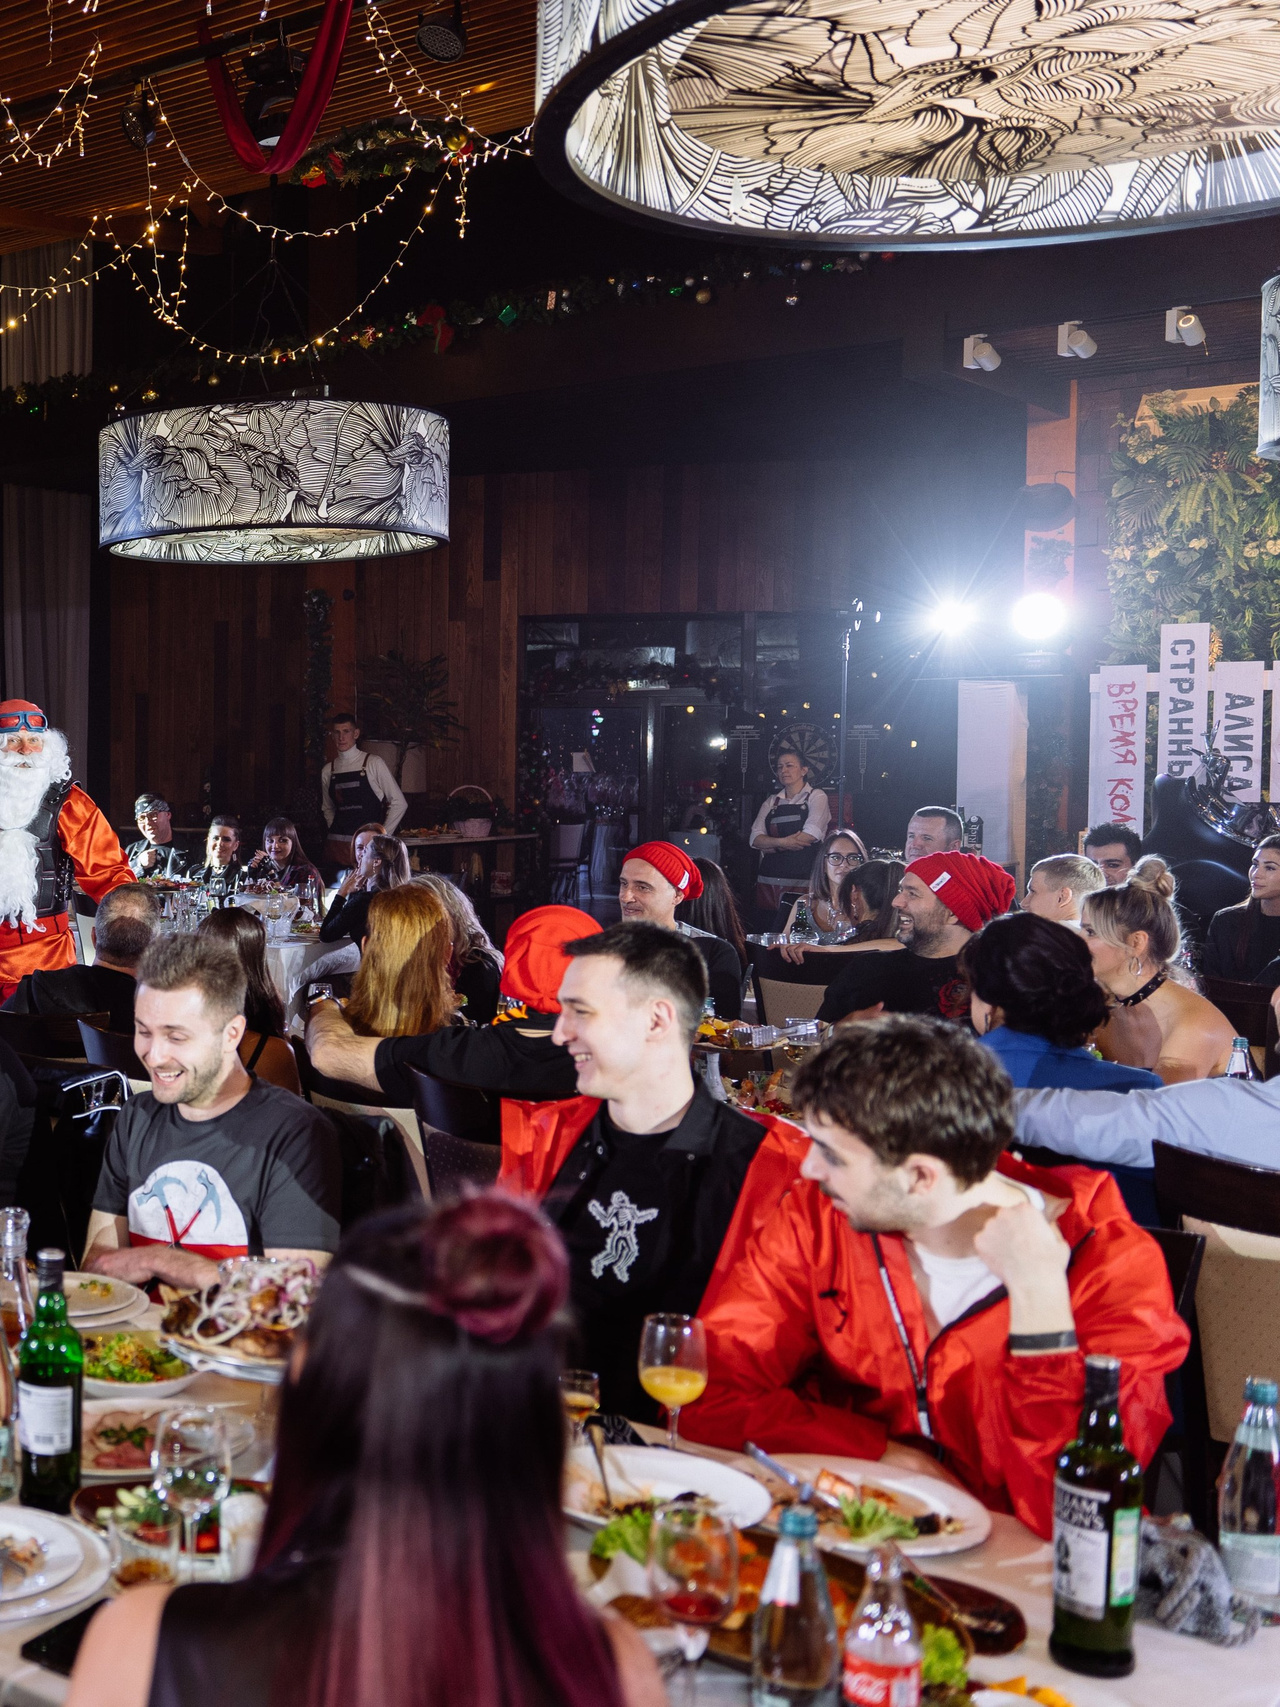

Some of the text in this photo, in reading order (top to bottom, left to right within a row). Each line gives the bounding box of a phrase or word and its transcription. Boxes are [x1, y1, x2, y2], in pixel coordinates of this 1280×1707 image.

[1107, 681, 1138, 823] ВРЕМЯ КОЛ
[1224, 692, 1255, 792] АЛИСА
[968, 824, 977, 843] Rich
